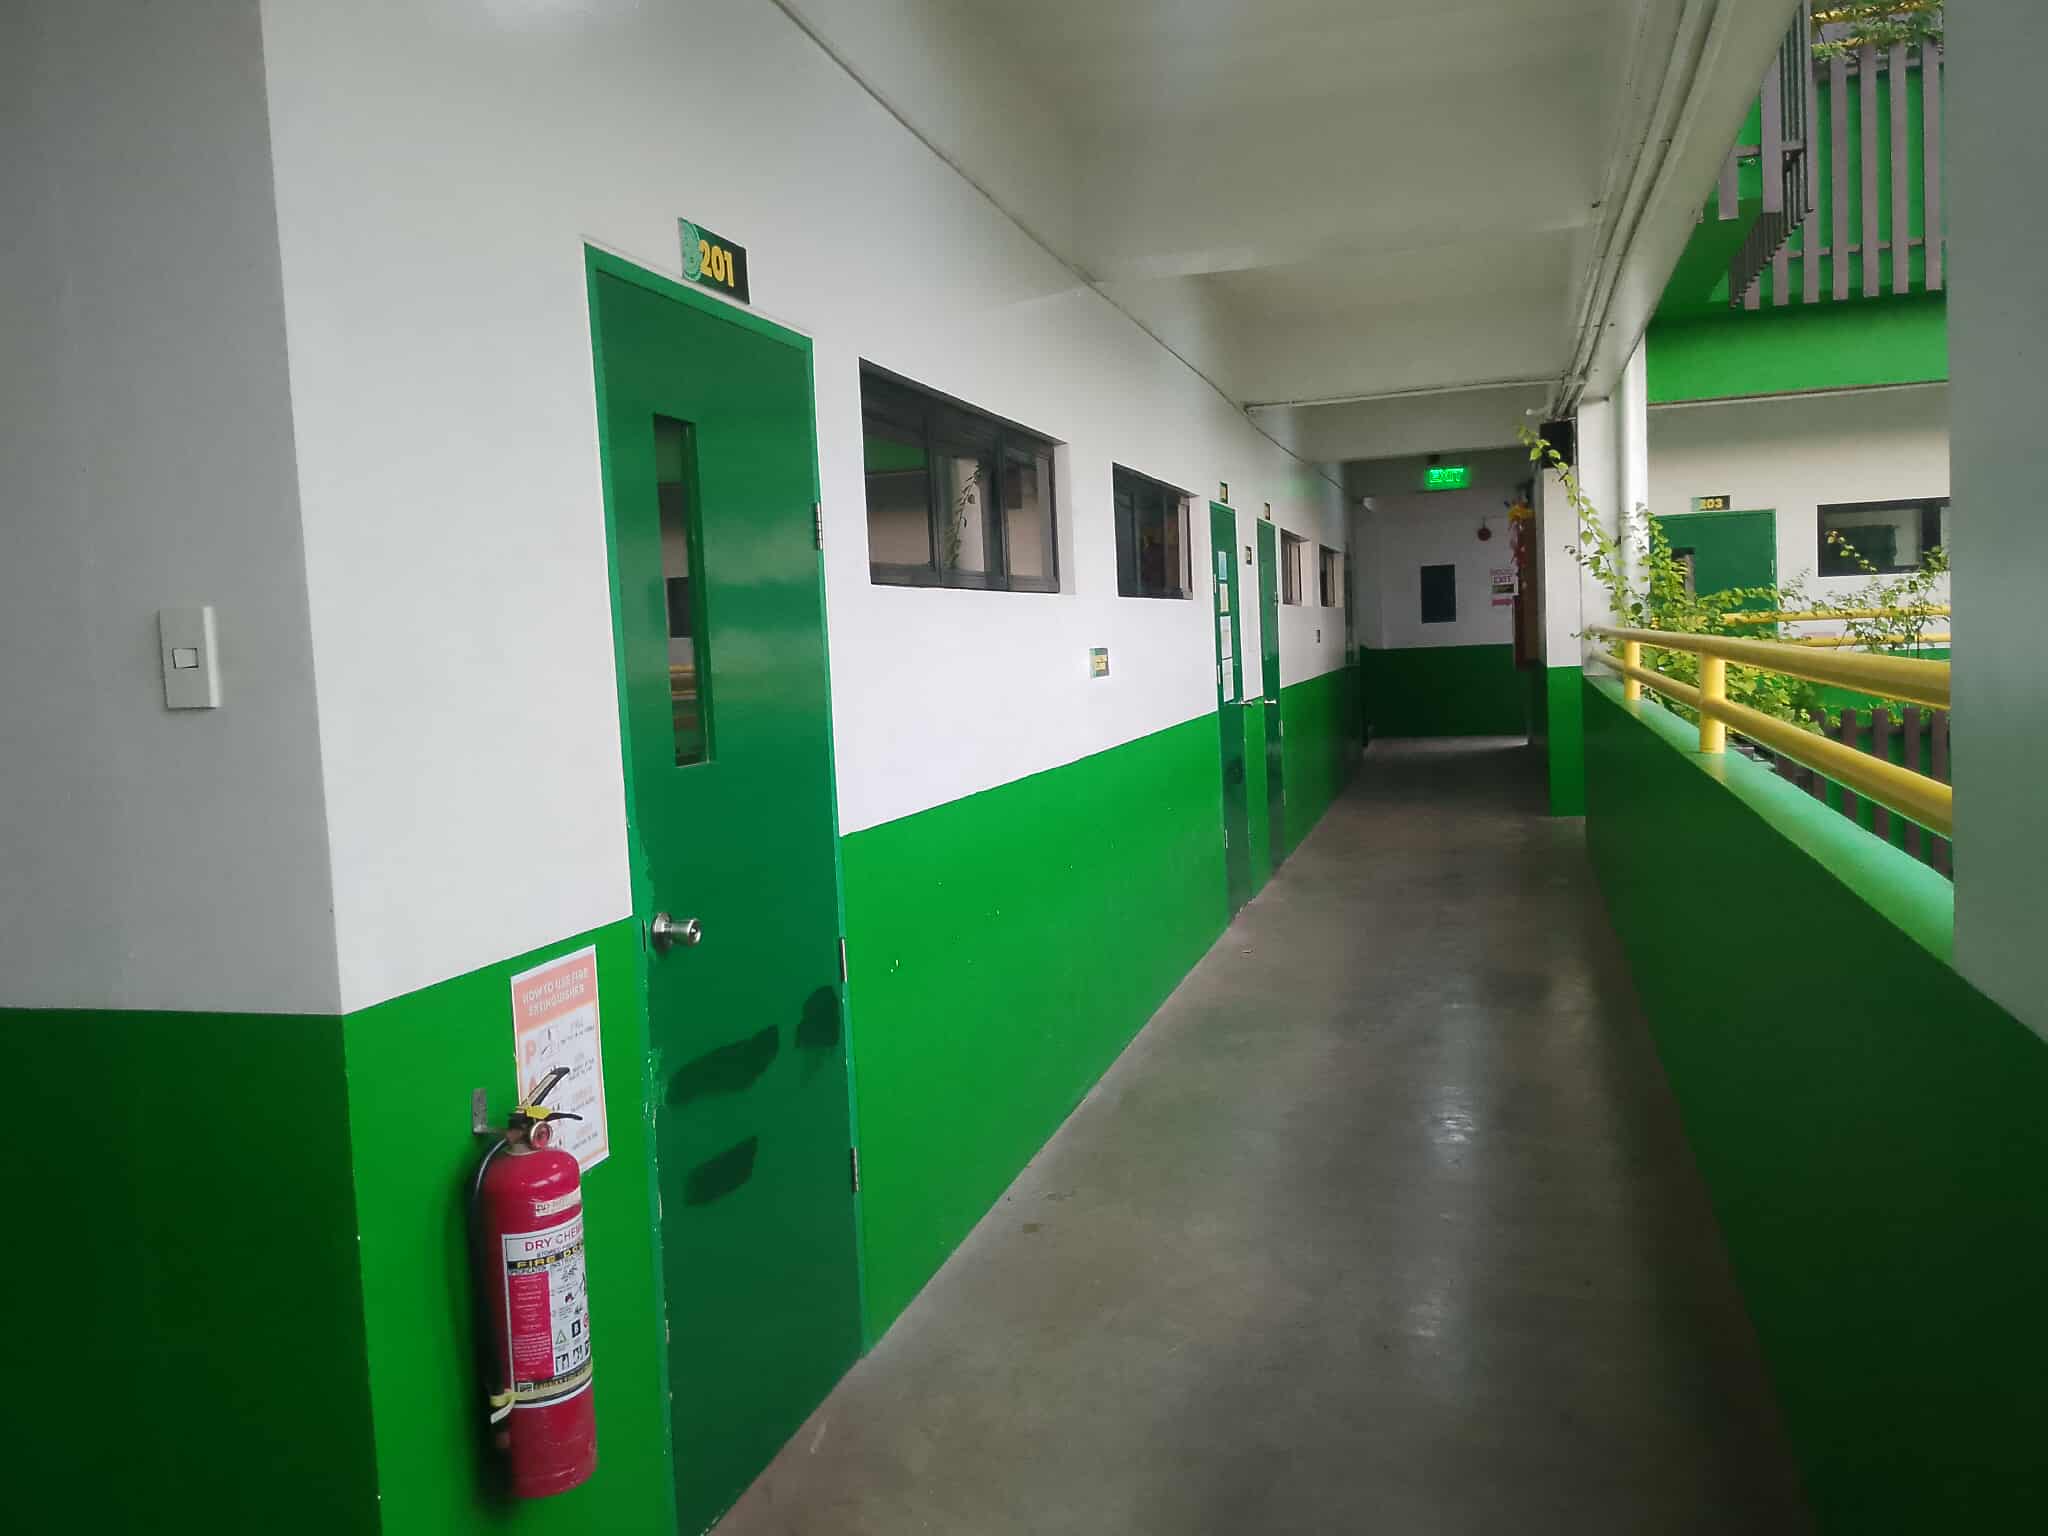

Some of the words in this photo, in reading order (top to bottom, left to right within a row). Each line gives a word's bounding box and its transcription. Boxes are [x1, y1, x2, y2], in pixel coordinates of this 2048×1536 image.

[699, 239, 735, 288] 201
[1429, 468, 1464, 483] EXIT
[522, 986, 543, 1005] HOW
[543, 982, 555, 993] TO
[555, 973, 571, 990] USE
[571, 967, 590, 984] FIRE
[528, 983, 585, 1016] EXTINGUISHER
[524, 1238, 553, 1252] DRY
[516, 1255, 556, 1269] FIRE
